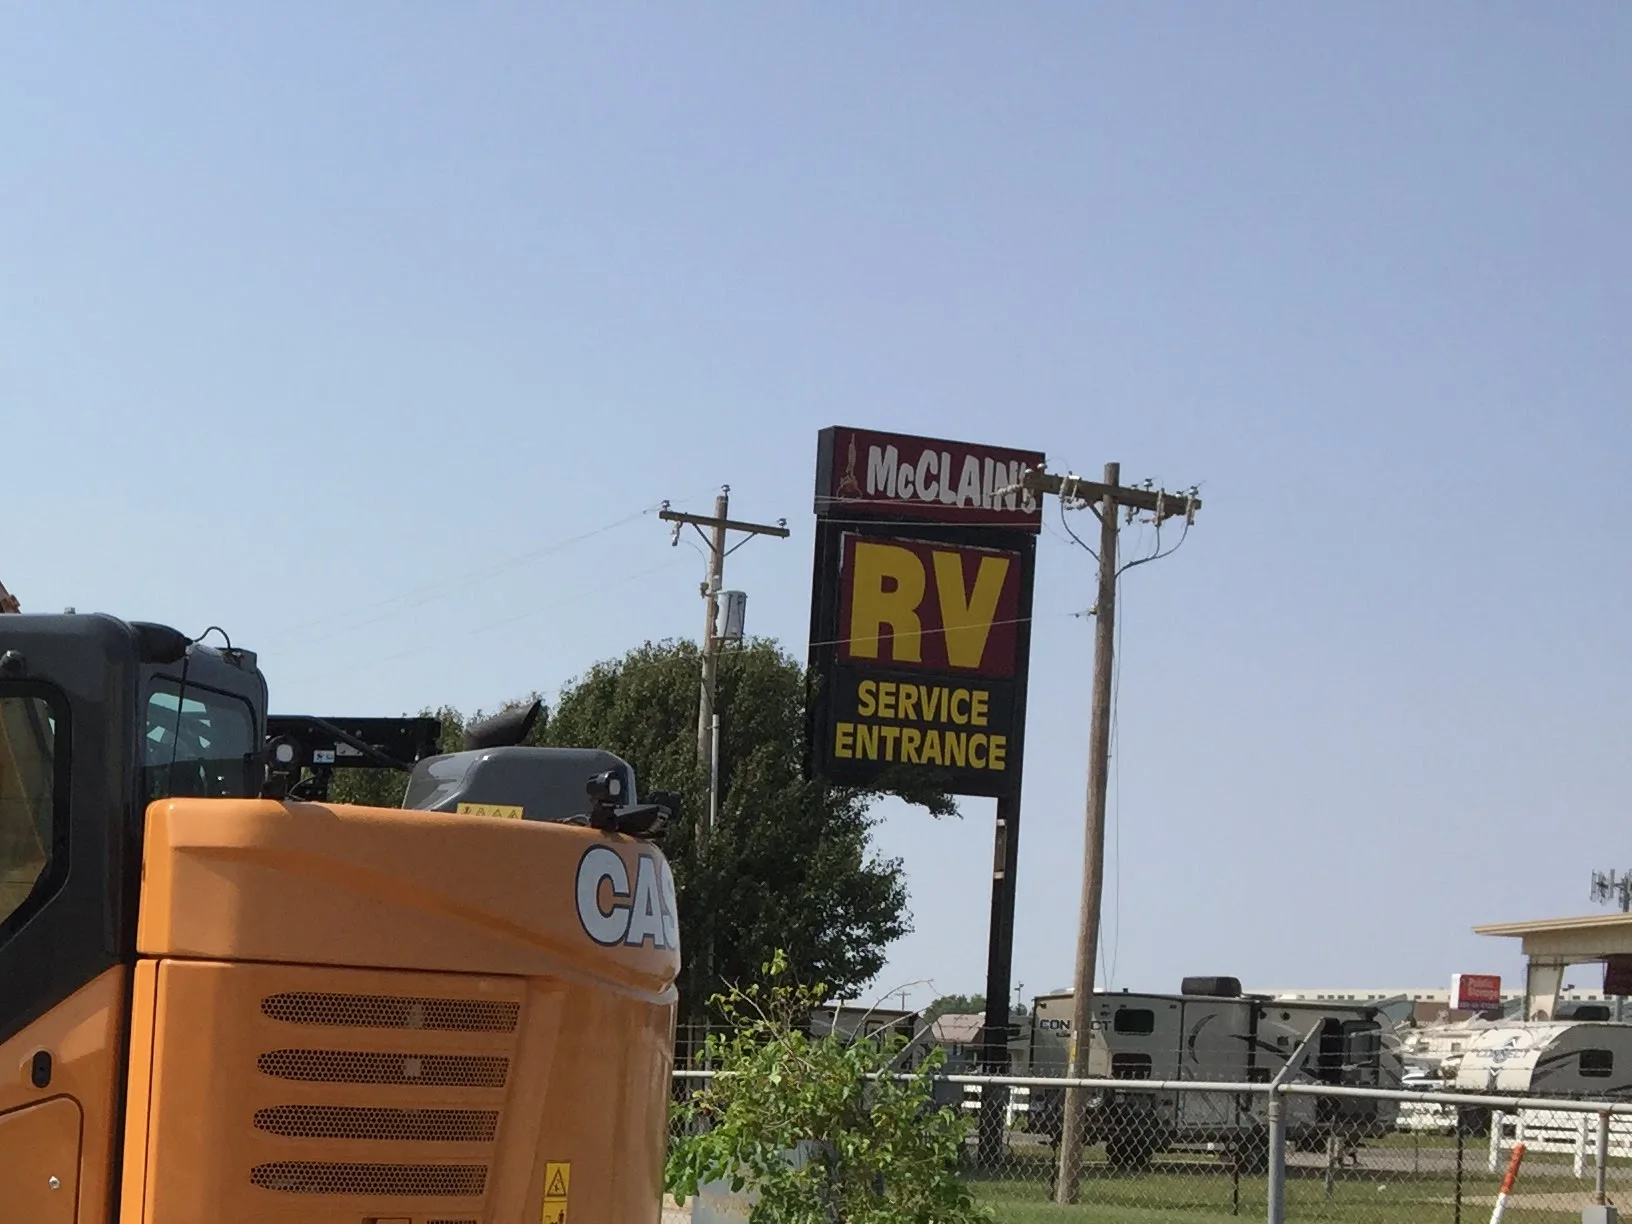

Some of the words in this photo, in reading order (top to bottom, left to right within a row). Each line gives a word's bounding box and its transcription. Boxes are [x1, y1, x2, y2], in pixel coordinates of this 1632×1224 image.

[849, 541, 1010, 669] RV
[858, 679, 989, 727] SERVICE
[835, 721, 1006, 771] ENTRANCE
